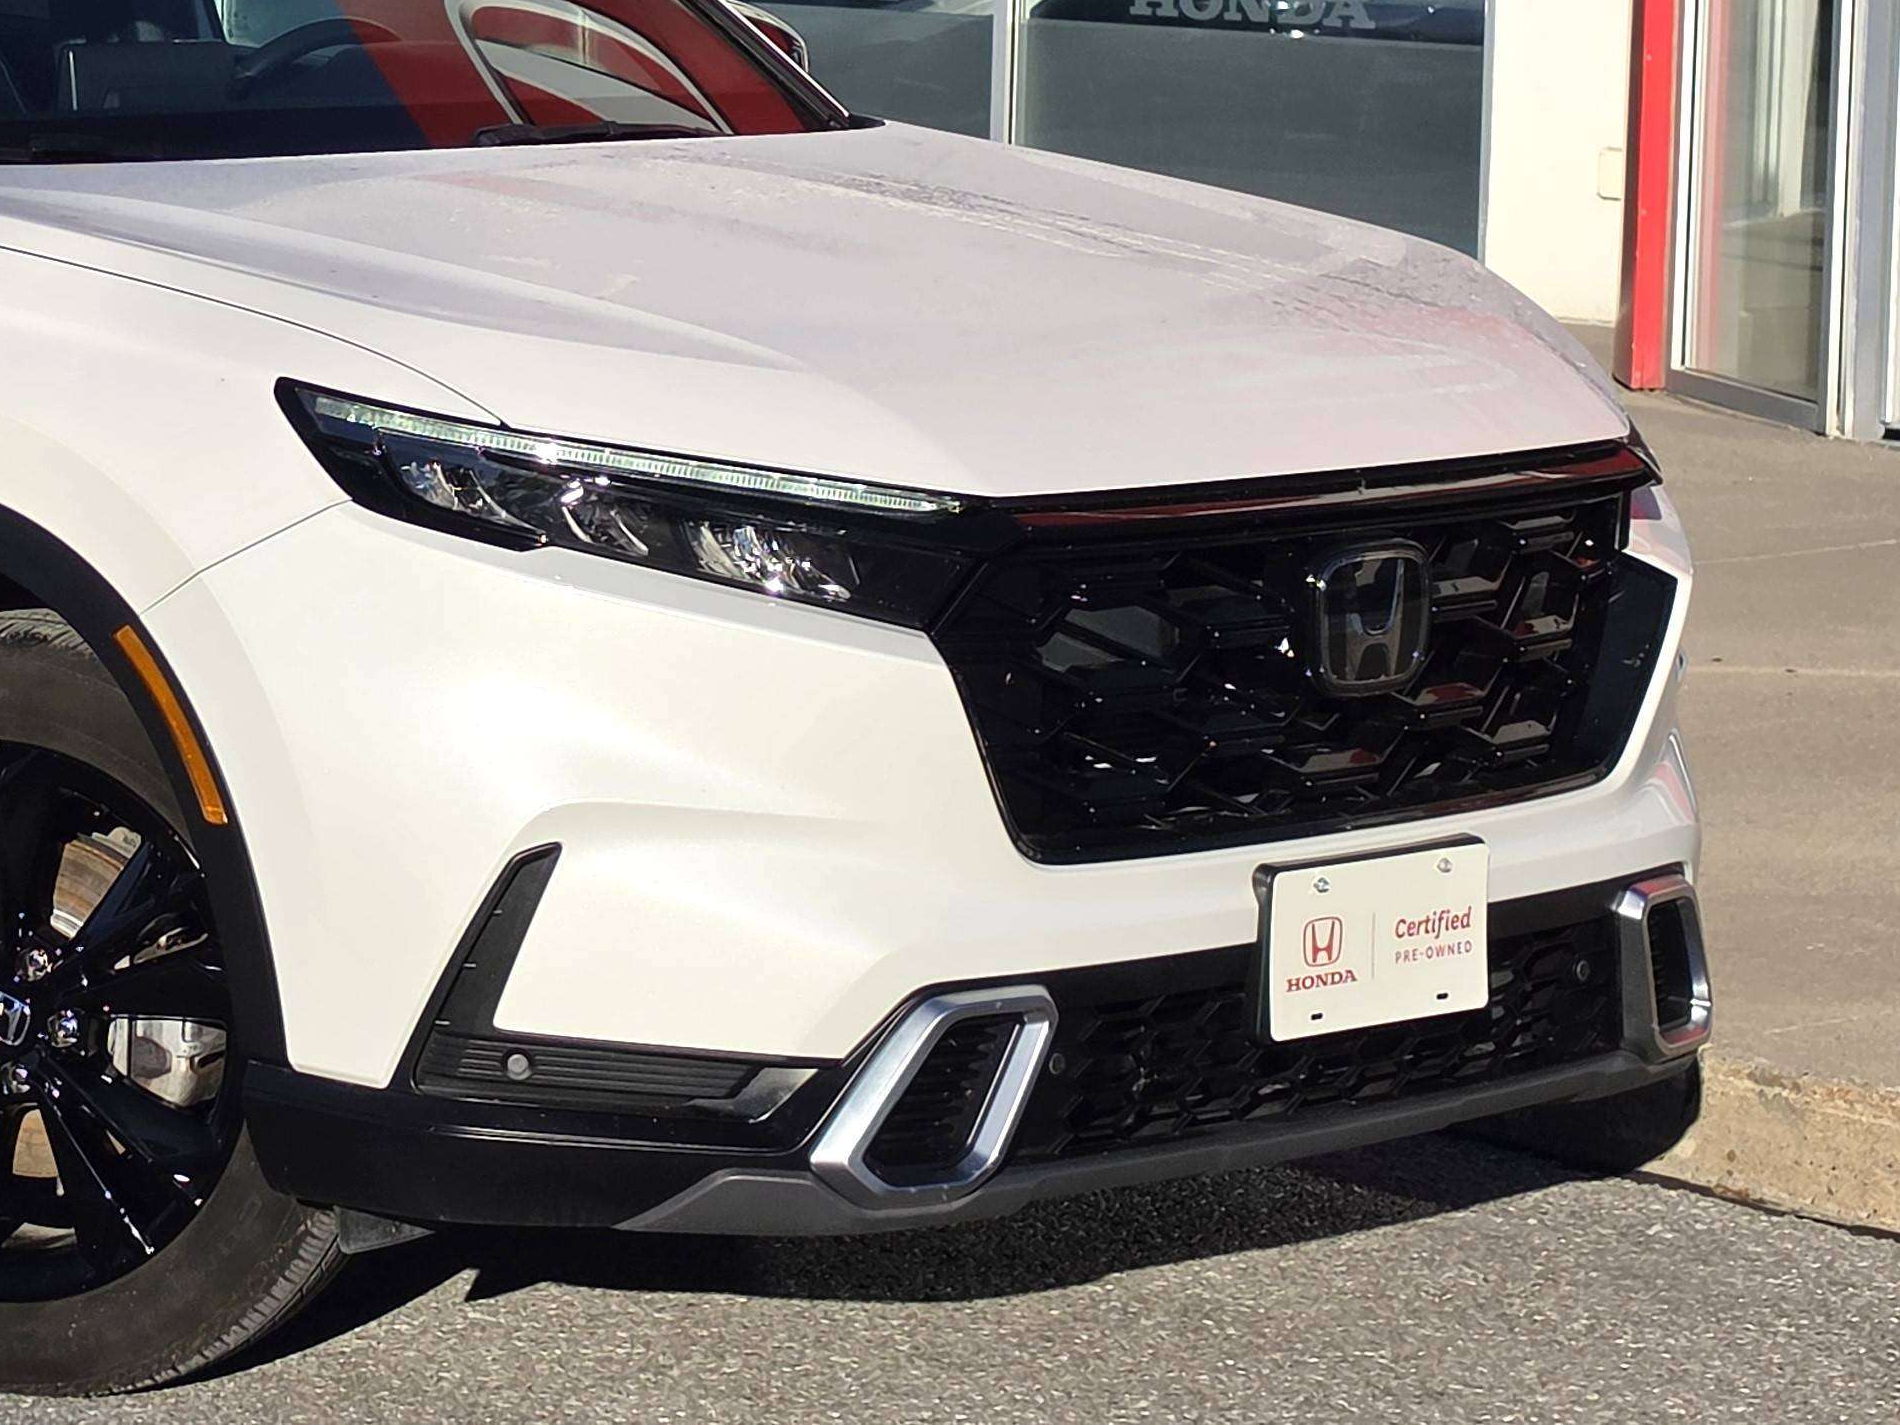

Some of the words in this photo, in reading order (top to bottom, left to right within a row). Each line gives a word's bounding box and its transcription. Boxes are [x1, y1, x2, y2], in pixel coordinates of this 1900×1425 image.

[1395, 906, 1472, 939] Certified
[1395, 940, 1472, 964] PRE-OWNED
[1286, 969, 1358, 992] HONDA
